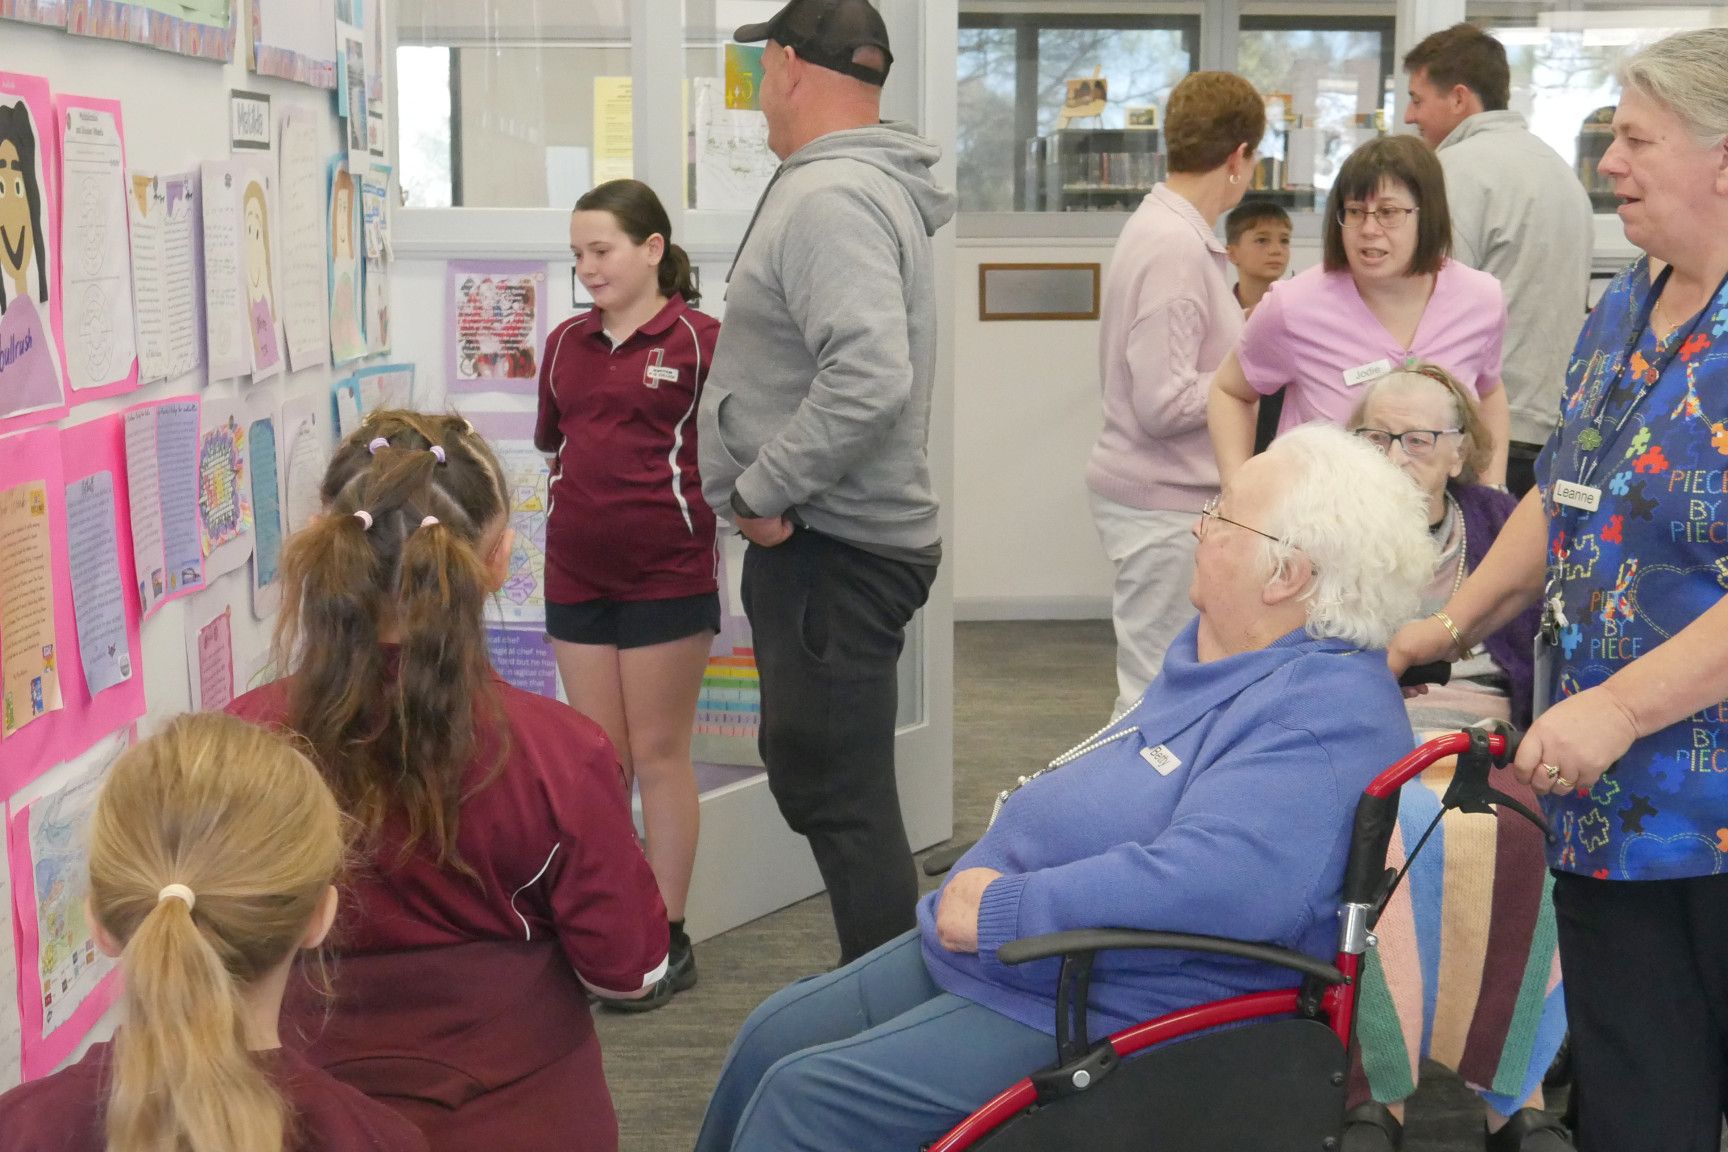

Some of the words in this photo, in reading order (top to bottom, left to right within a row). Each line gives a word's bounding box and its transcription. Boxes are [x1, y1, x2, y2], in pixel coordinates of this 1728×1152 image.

[1355, 366, 1383, 381] Jodie
[1556, 483, 1594, 504] Leanne
[1689, 499, 1721, 521] BY
[1670, 520, 1728, 544] PIEC
[1604, 618, 1627, 637] BY
[1590, 636, 1643, 660] PIECE
[1692, 727, 1721, 749] BY
[1676, 748, 1728, 773] PIEC
